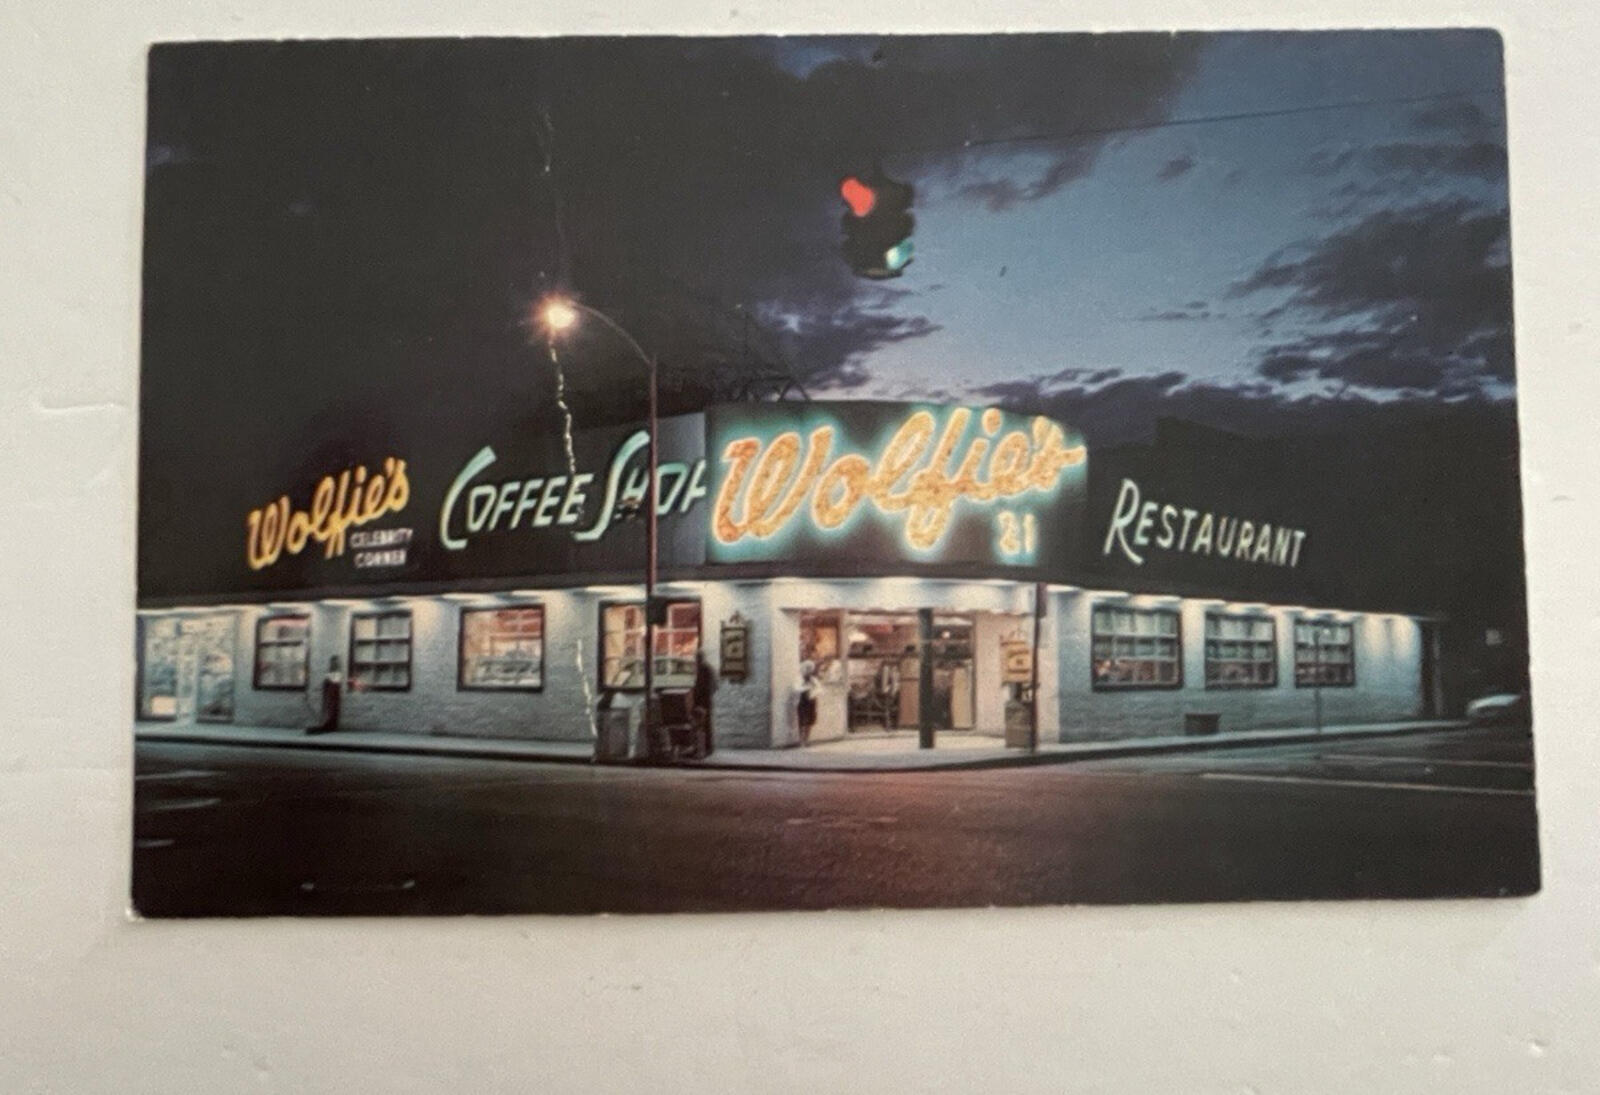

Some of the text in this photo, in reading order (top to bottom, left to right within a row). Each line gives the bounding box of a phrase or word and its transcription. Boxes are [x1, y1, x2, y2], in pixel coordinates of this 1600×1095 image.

[247, 456, 409, 570] Wolfie's
[440, 446, 594, 550] COFFEE
[713, 407, 1087, 552] Wolfie's
[1104, 478, 1306, 567] RESTAURANT
